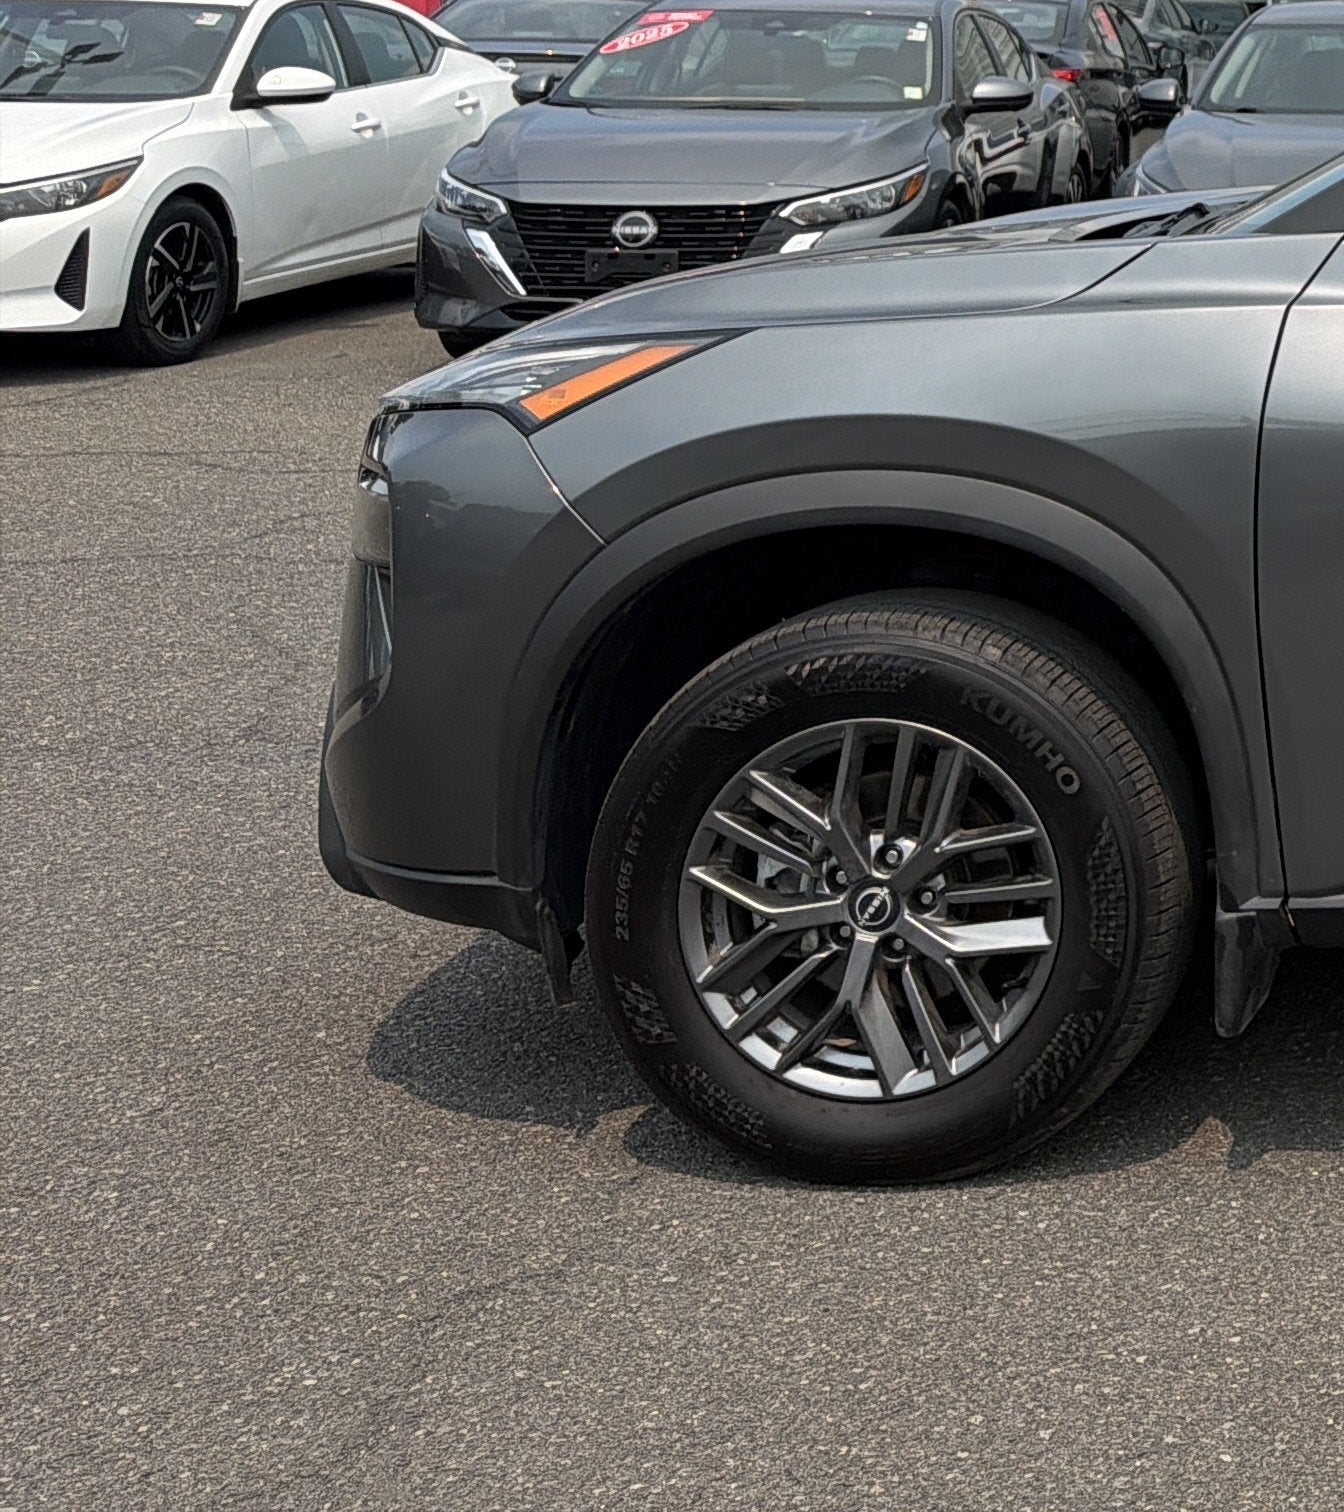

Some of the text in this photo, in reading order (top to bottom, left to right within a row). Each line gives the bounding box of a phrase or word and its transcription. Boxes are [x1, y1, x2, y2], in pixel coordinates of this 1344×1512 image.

[960, 685, 1080, 795] KUMHO
[614, 809, 648, 942] 235/65 R17
